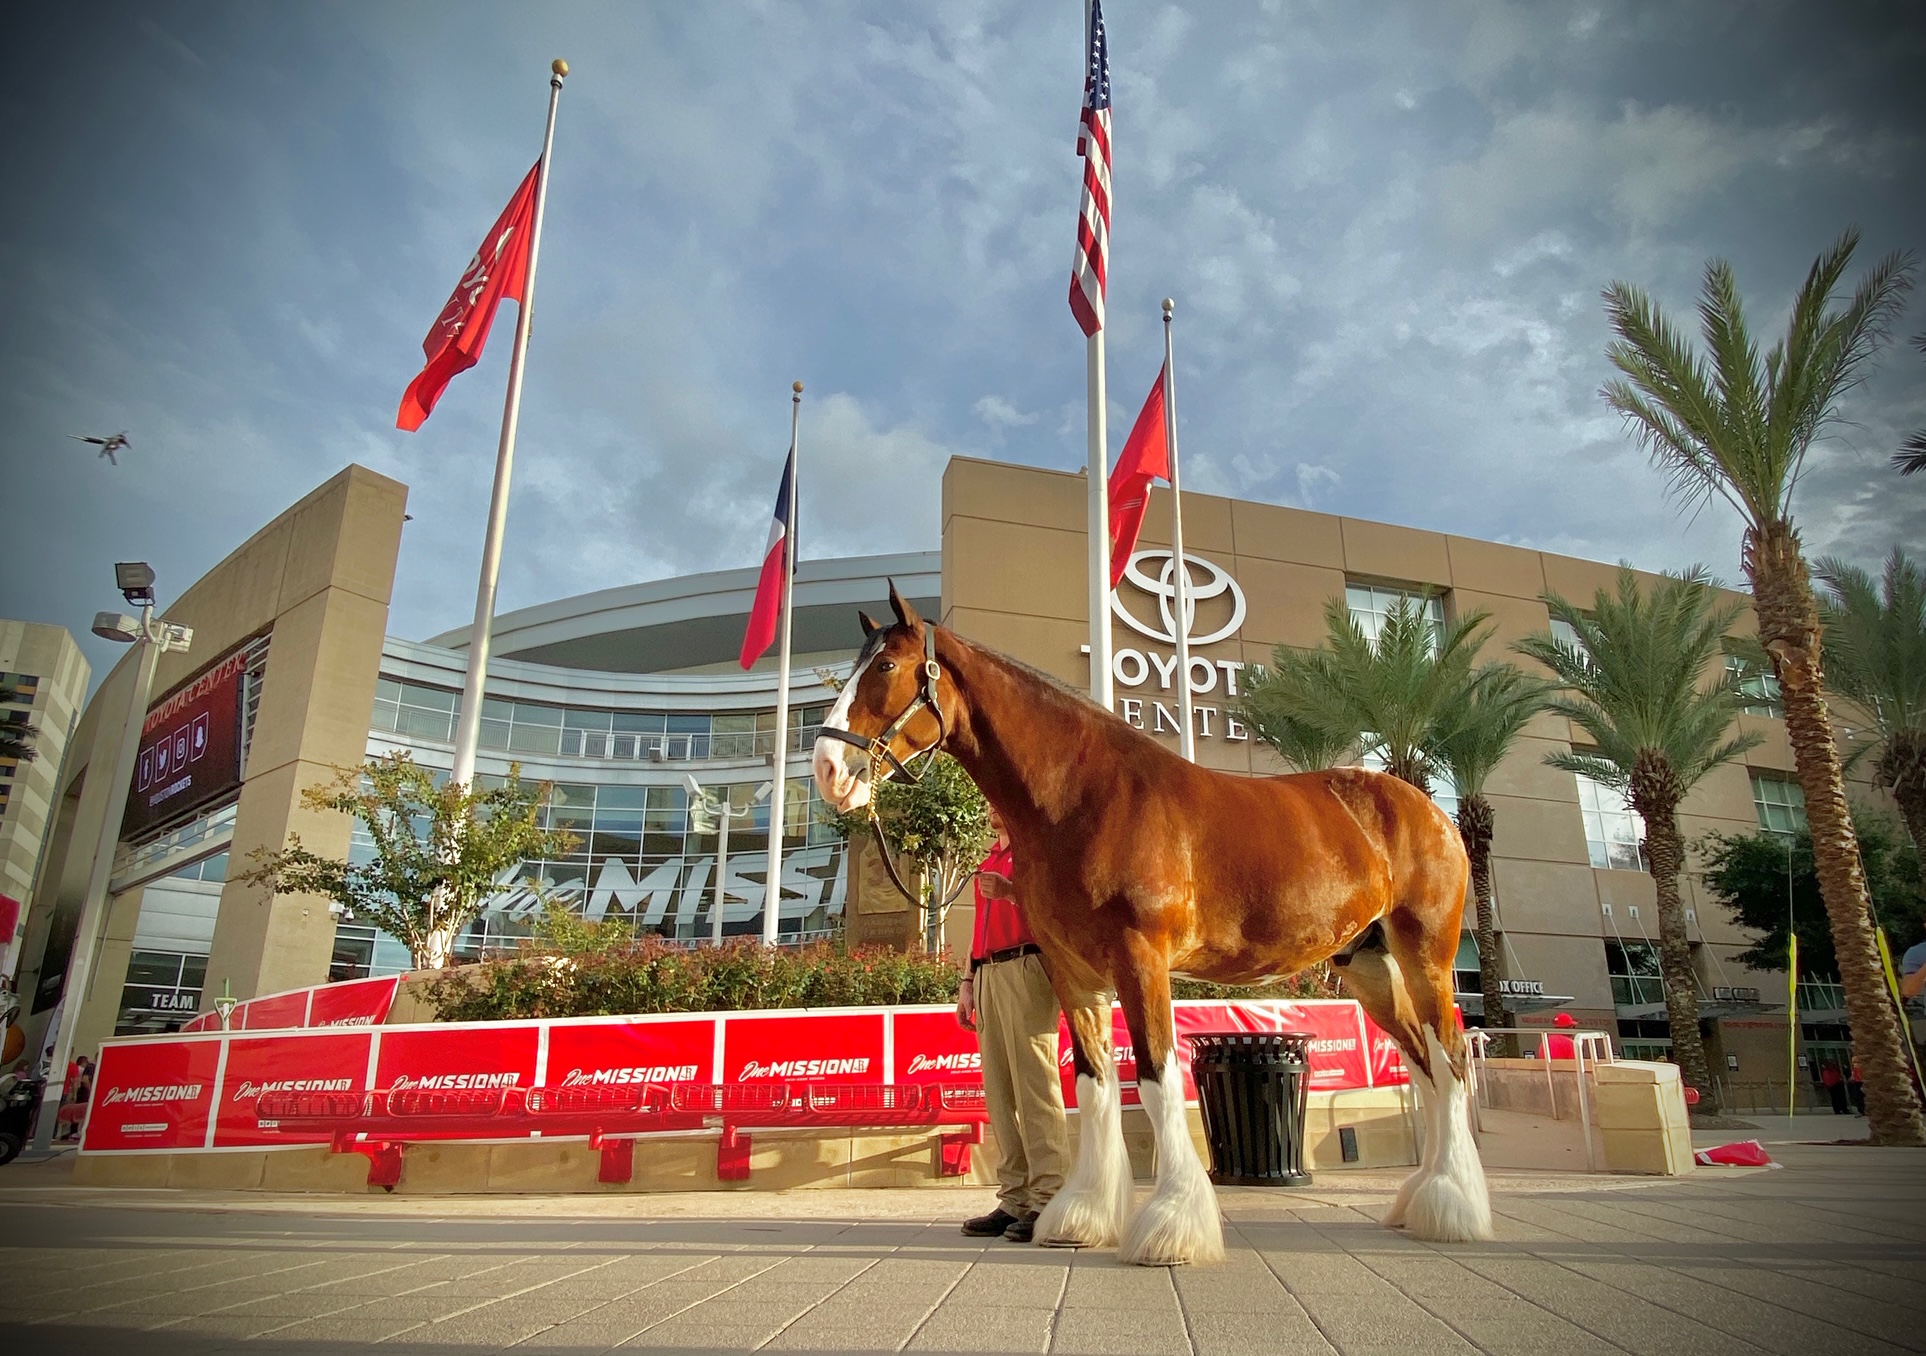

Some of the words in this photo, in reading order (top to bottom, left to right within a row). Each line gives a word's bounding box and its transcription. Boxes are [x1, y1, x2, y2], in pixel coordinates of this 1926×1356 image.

[1081, 644, 1269, 697] OYOT
[1121, 697, 1281, 742] ENTE
[584, 846, 848, 924] MISSI
[1511, 980, 1544, 993] OFFICE
[152, 994, 194, 1009] TEAM
[1308, 1039, 1349, 1053] MISSION
[738, 1060, 770, 1082] One
[768, 1058, 855, 1077] MISSION
[907, 1053, 937, 1075] One
[935, 1052, 981, 1070] MISS
[418, 1073, 503, 1089] MISSION
[592, 1066, 681, 1085] MISSION
[123, 1085, 190, 1102] MISSION
[233, 1081, 261, 1102] One
